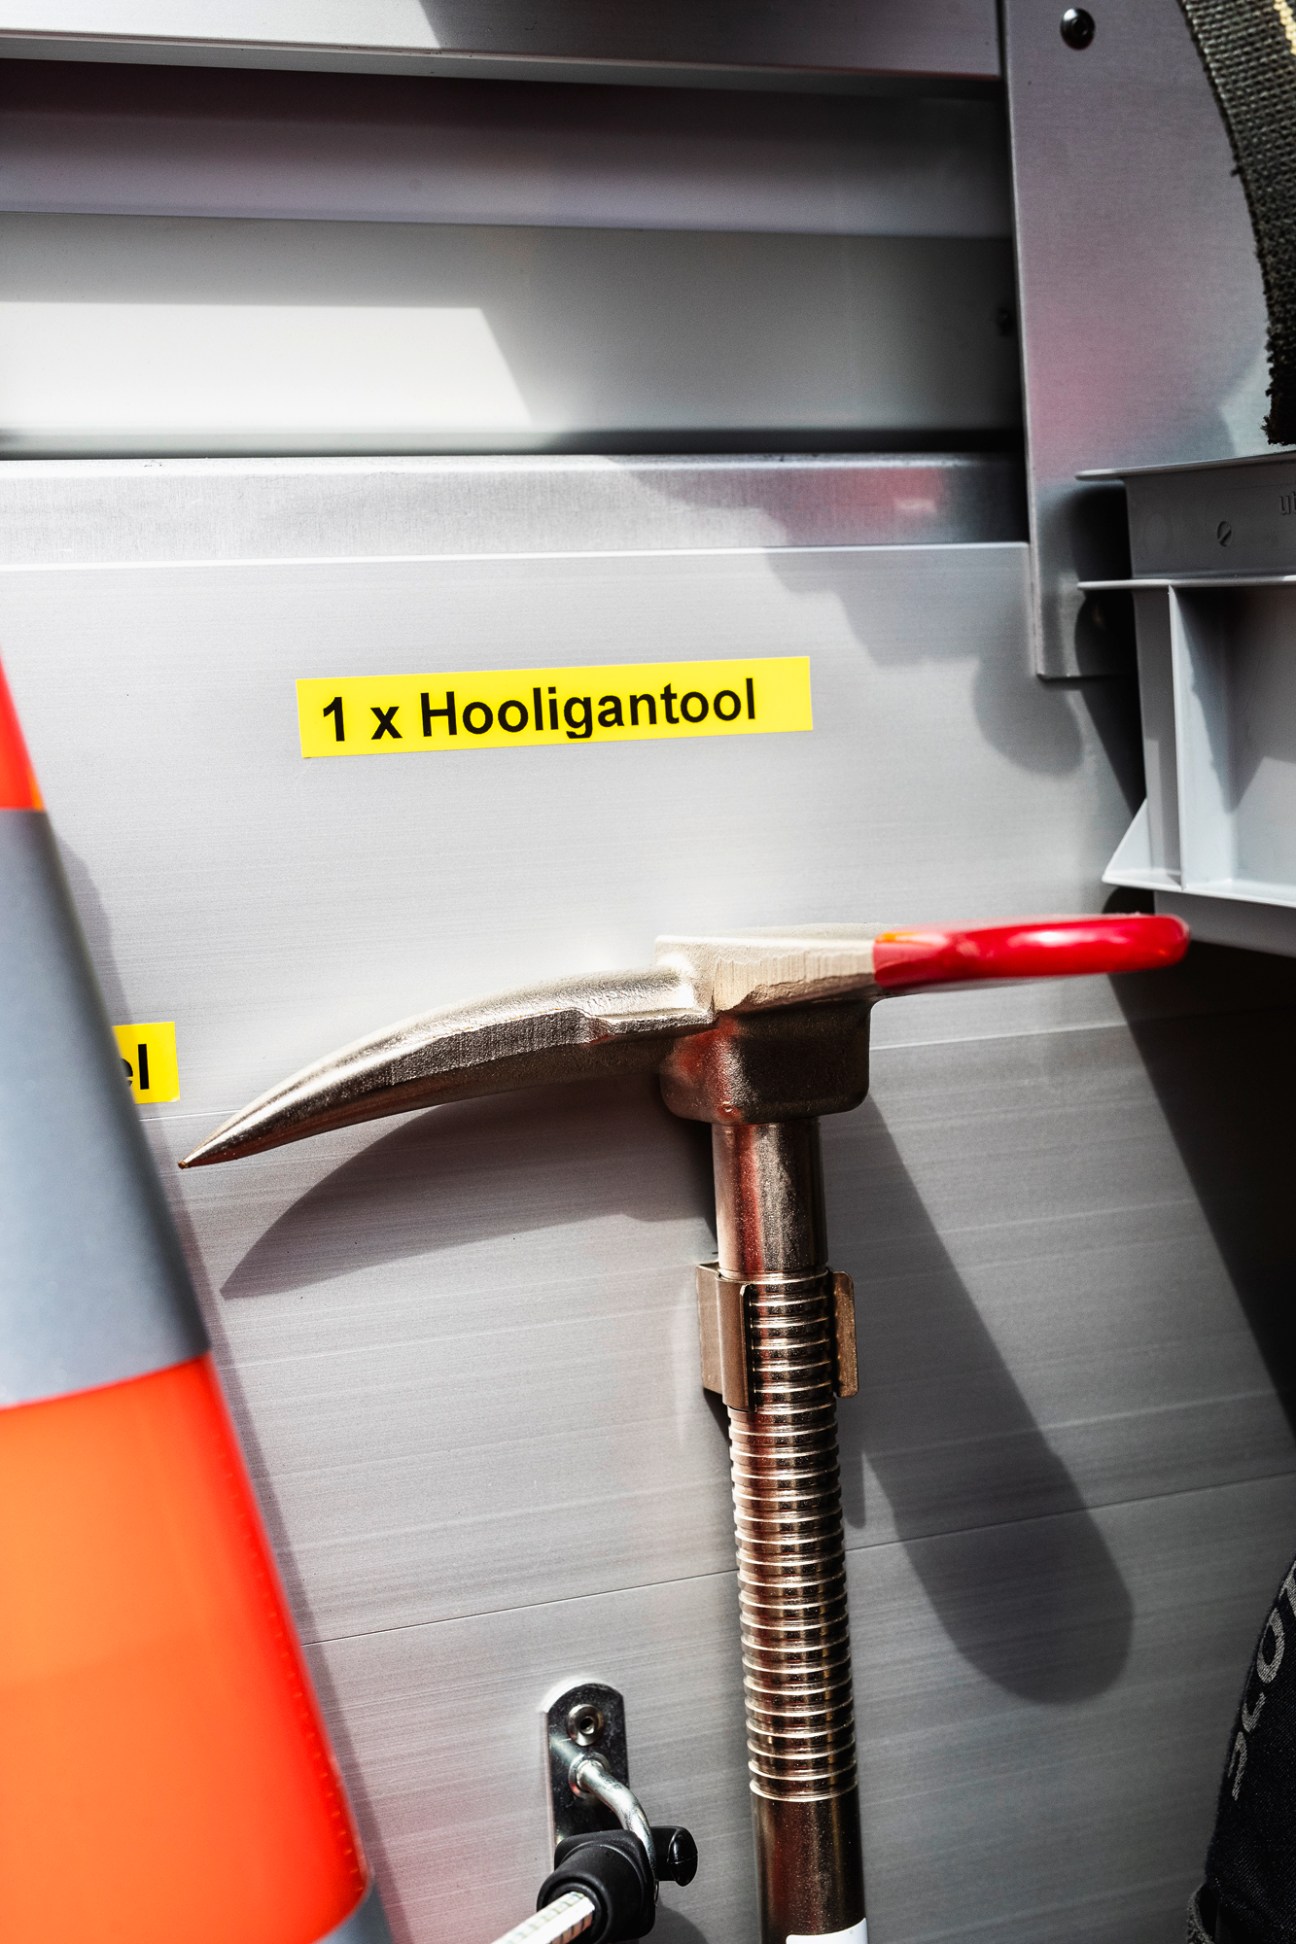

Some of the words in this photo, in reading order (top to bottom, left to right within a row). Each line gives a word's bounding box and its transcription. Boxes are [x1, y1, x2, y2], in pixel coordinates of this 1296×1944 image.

[322, 696, 346, 742] 1
[370, 706, 402, 740] x
[420, 677, 756, 739] Hooligantool
